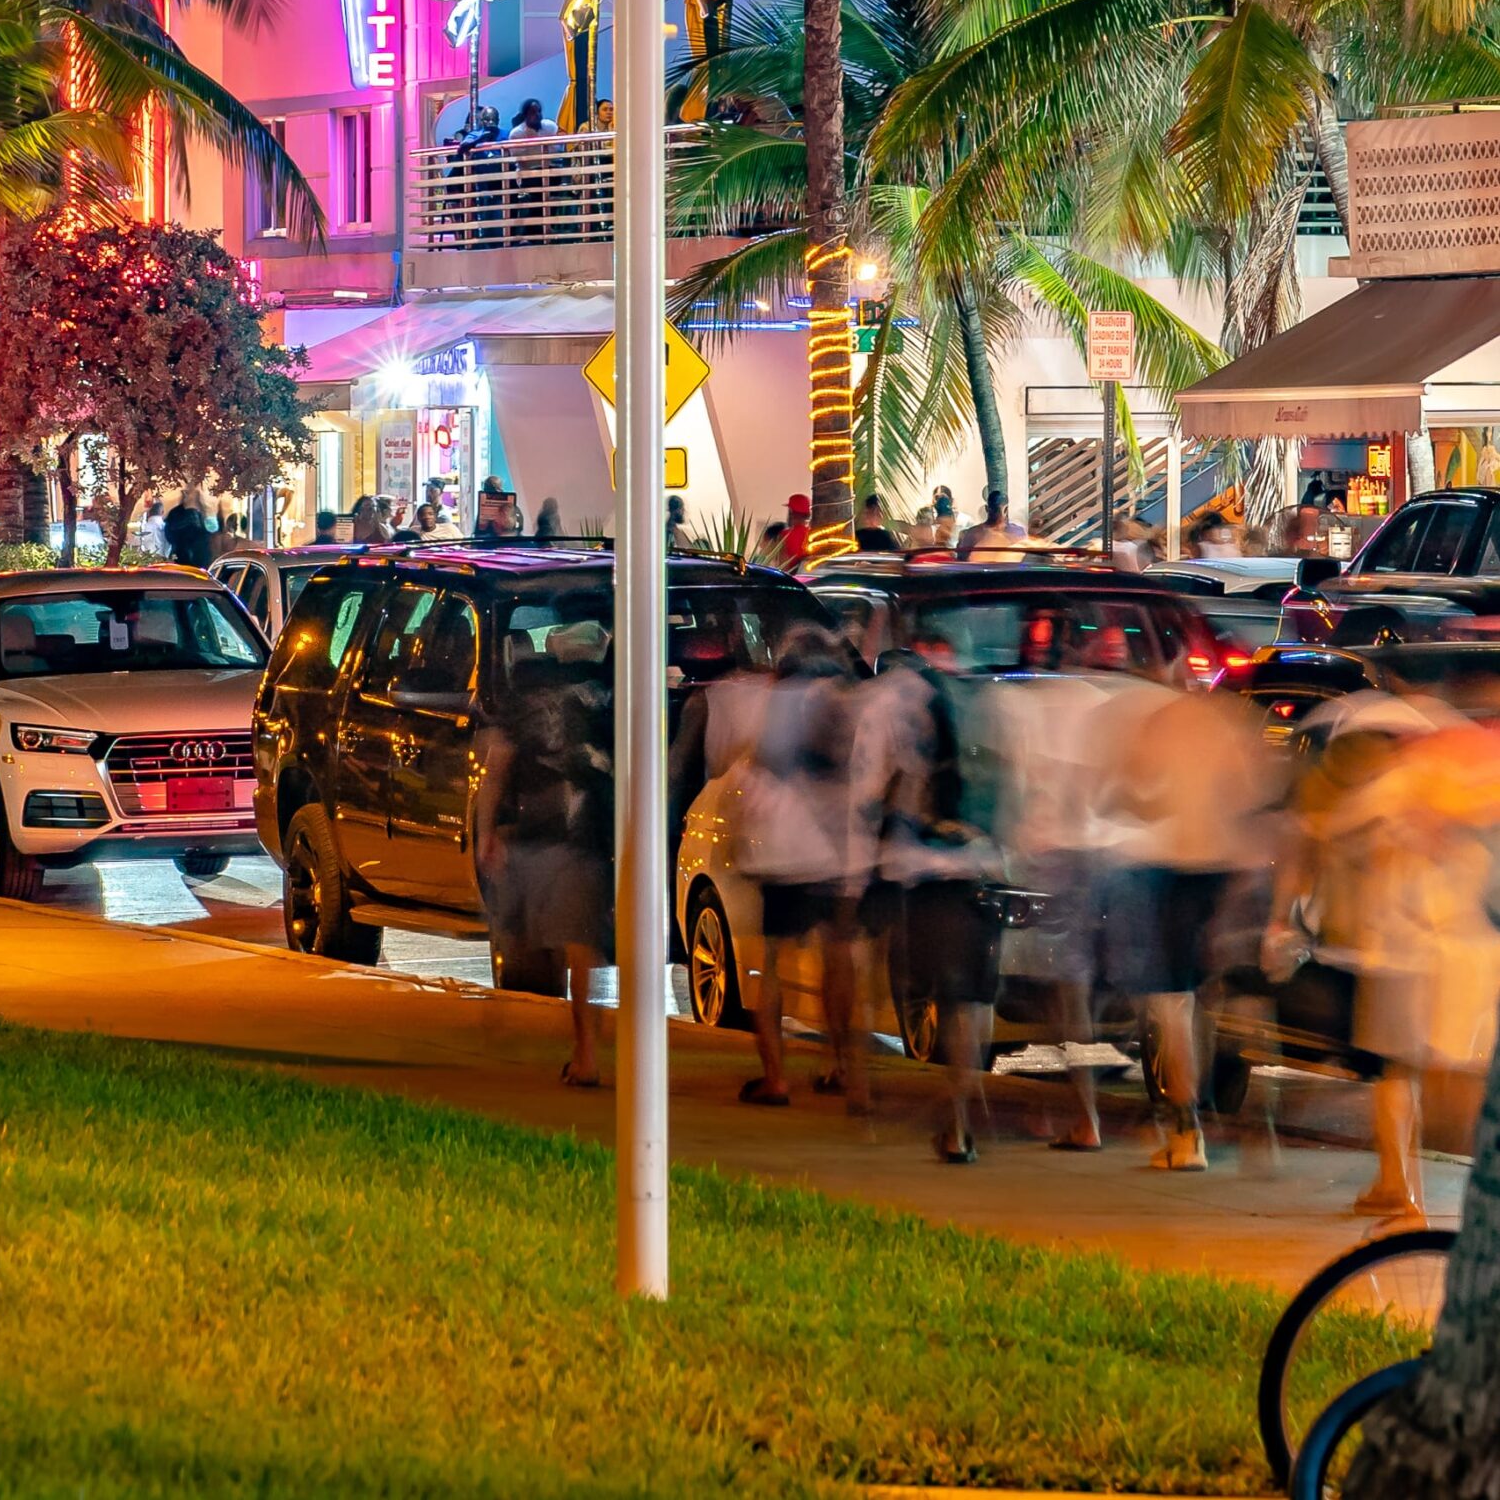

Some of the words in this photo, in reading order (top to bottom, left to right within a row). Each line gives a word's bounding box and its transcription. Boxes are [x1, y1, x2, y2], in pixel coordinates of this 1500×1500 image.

[1095, 316, 1126, 327] PASSENGER
[1092, 330, 1114, 340] LOADING
[1116, 330, 1129, 340] ZONE
[1092, 345, 1106, 355] VALET
[1108, 345, 1129, 356] PARKING
[1106, 358, 1122, 368] HOURS
